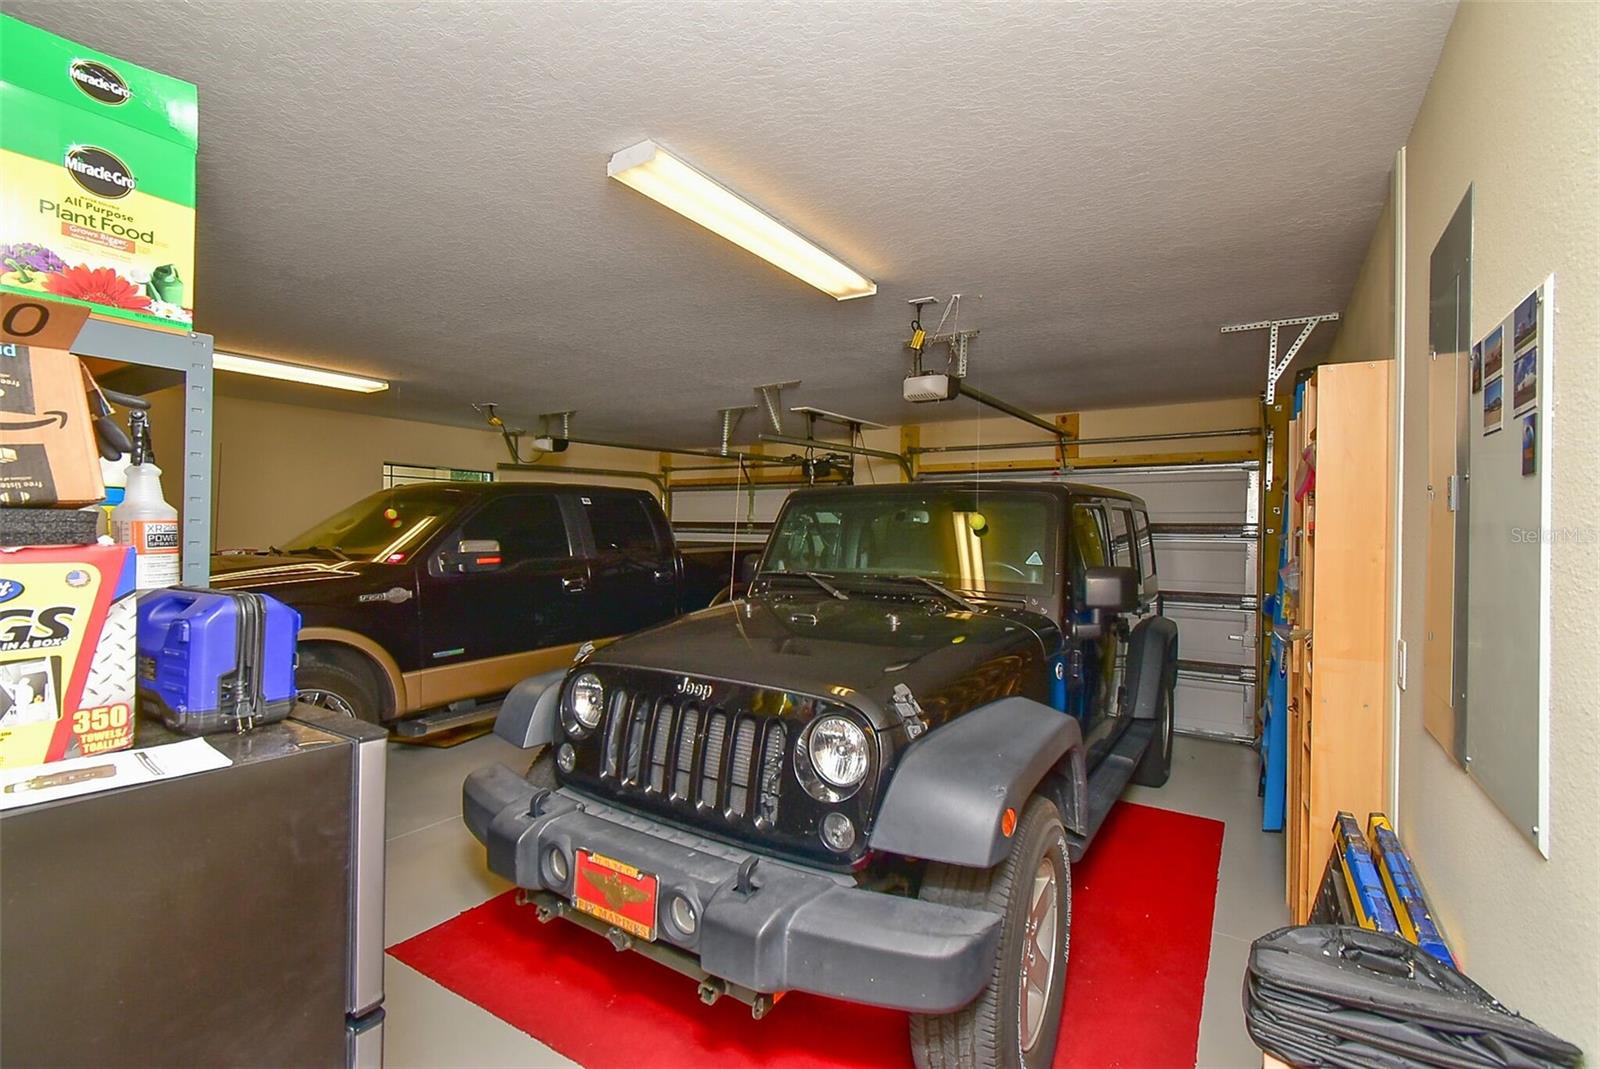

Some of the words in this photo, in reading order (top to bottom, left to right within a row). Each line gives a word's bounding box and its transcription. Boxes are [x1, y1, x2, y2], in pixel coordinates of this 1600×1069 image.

[64, 155, 136, 189] Miracle-Gro
[39, 199, 97, 229] Plant
[101, 216, 154, 245] Food
[64, 196, 82, 208] All
[85, 202, 134, 223] Purpose
[1, 642, 20, 651] IN
[20, 640, 31, 650] A
[31, 638, 62, 649] BOX
[676, 677, 712, 700] Jeep
[72, 704, 128, 734] 350
